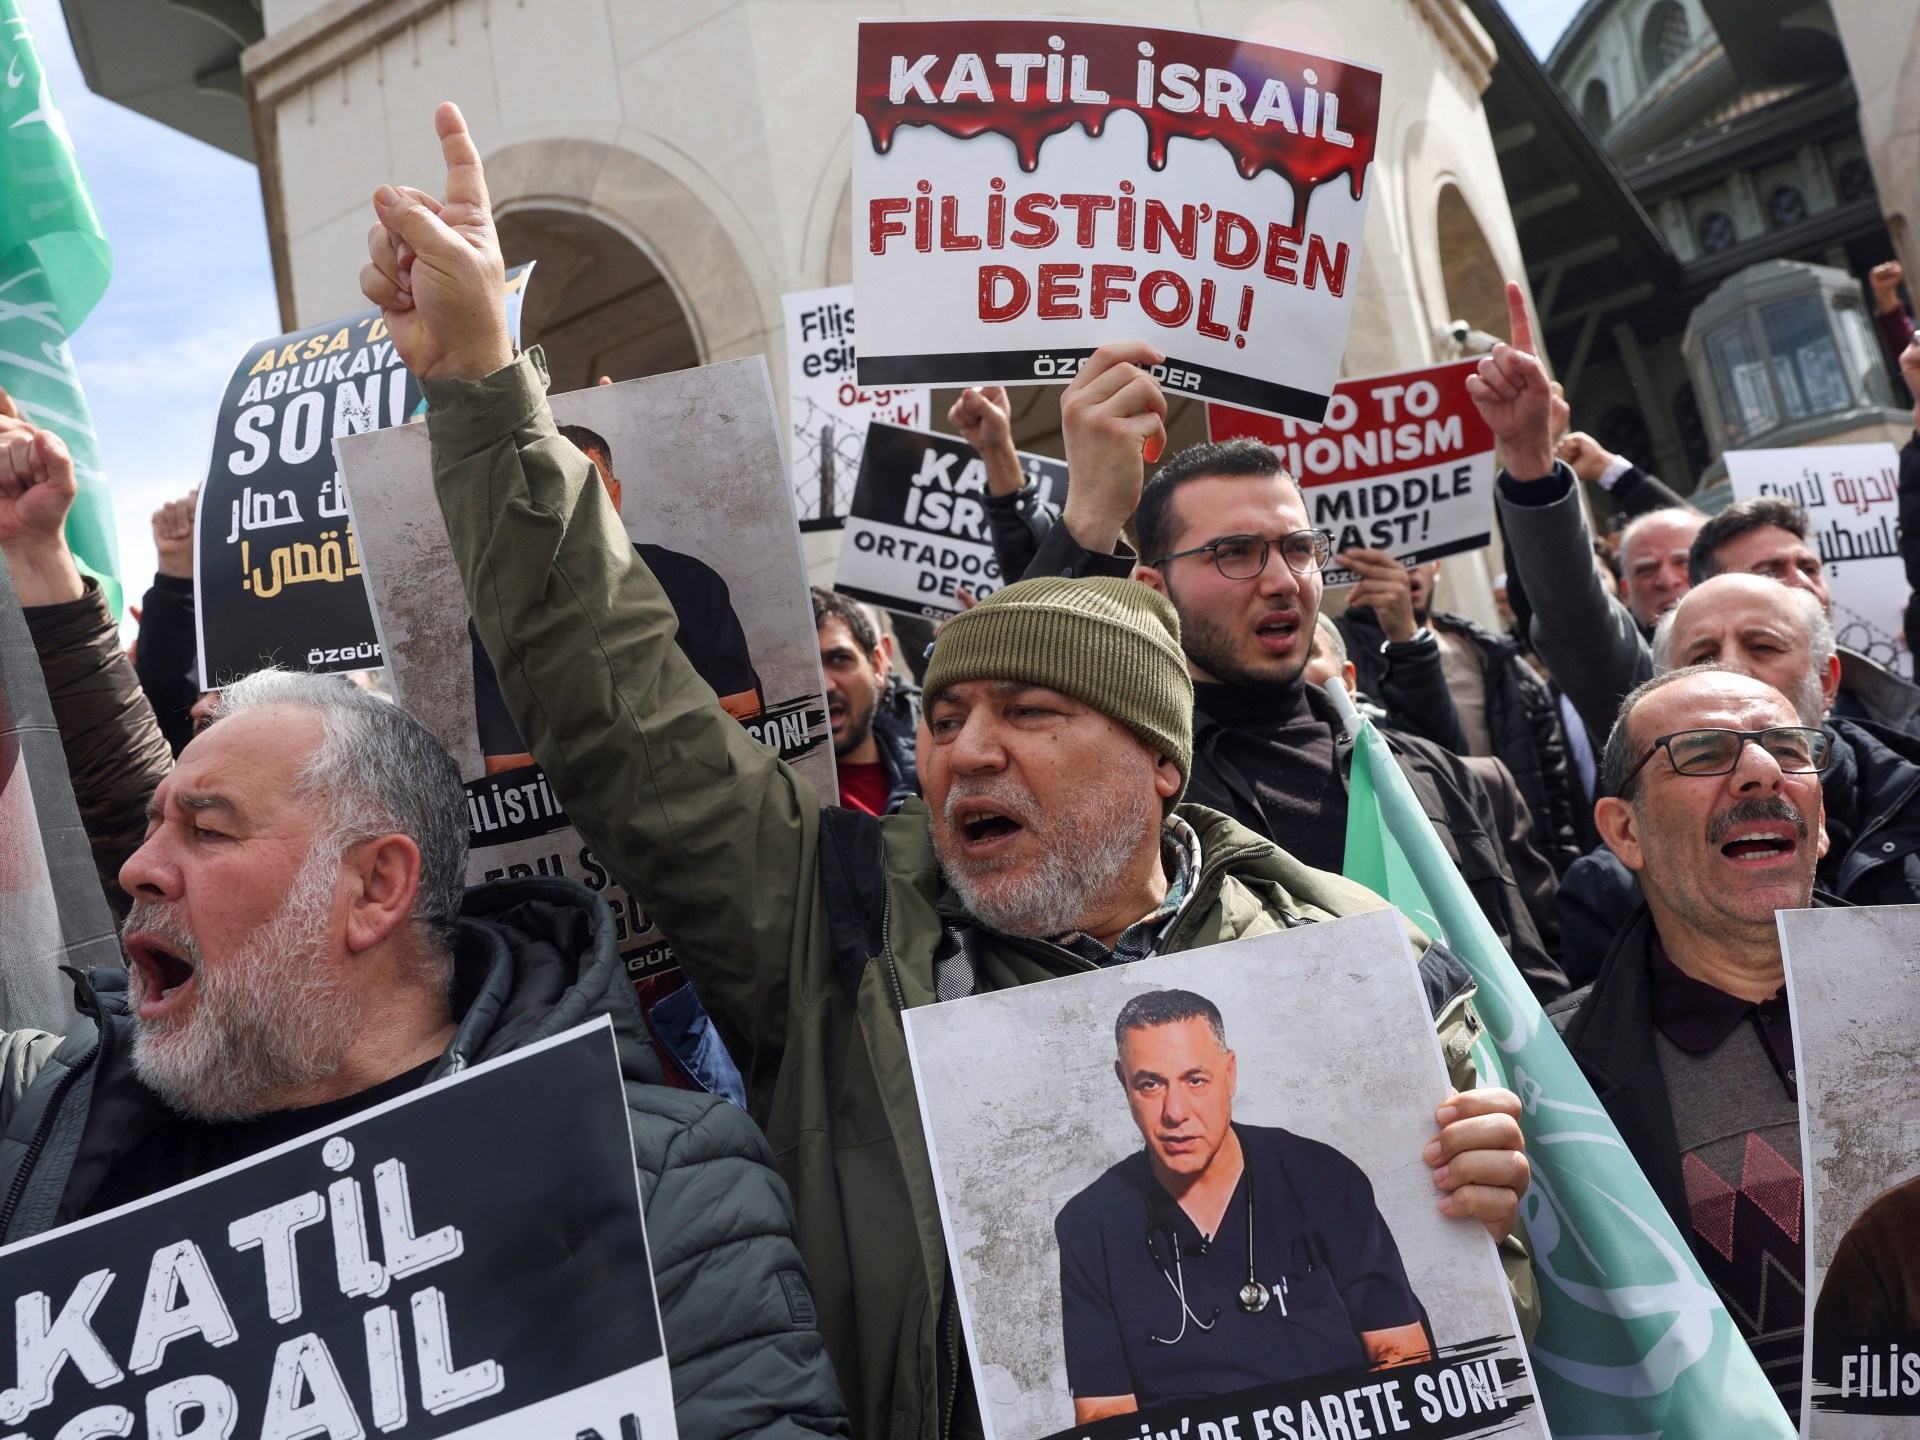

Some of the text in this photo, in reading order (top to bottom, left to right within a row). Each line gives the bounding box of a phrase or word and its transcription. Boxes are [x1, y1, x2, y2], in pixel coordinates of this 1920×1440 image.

[889, 35, 1355, 148] KATİL İSRAİL
[869, 177, 1350, 299] FİLİSTİN'DEN
[977, 263, 1255, 350] DEFOL!
[238, 340, 404, 407] ABLUKAYA
[1371, 380, 1439, 422] TO
[228, 367, 407, 476] SON!
[226, 487, 304, 544] حصار
[904, 473, 993, 542] İSR
[1315, 465, 1472, 524] MIDDLE
[466, 773, 563, 833] İLİSTİ
[15, 1136, 464, 1407] KATİL
[1253, 1380, 1411, 1440] ESARETE
[1414, 1358, 1509, 1424] SON!
[1841, 1343, 1920, 1398] FİLİS
